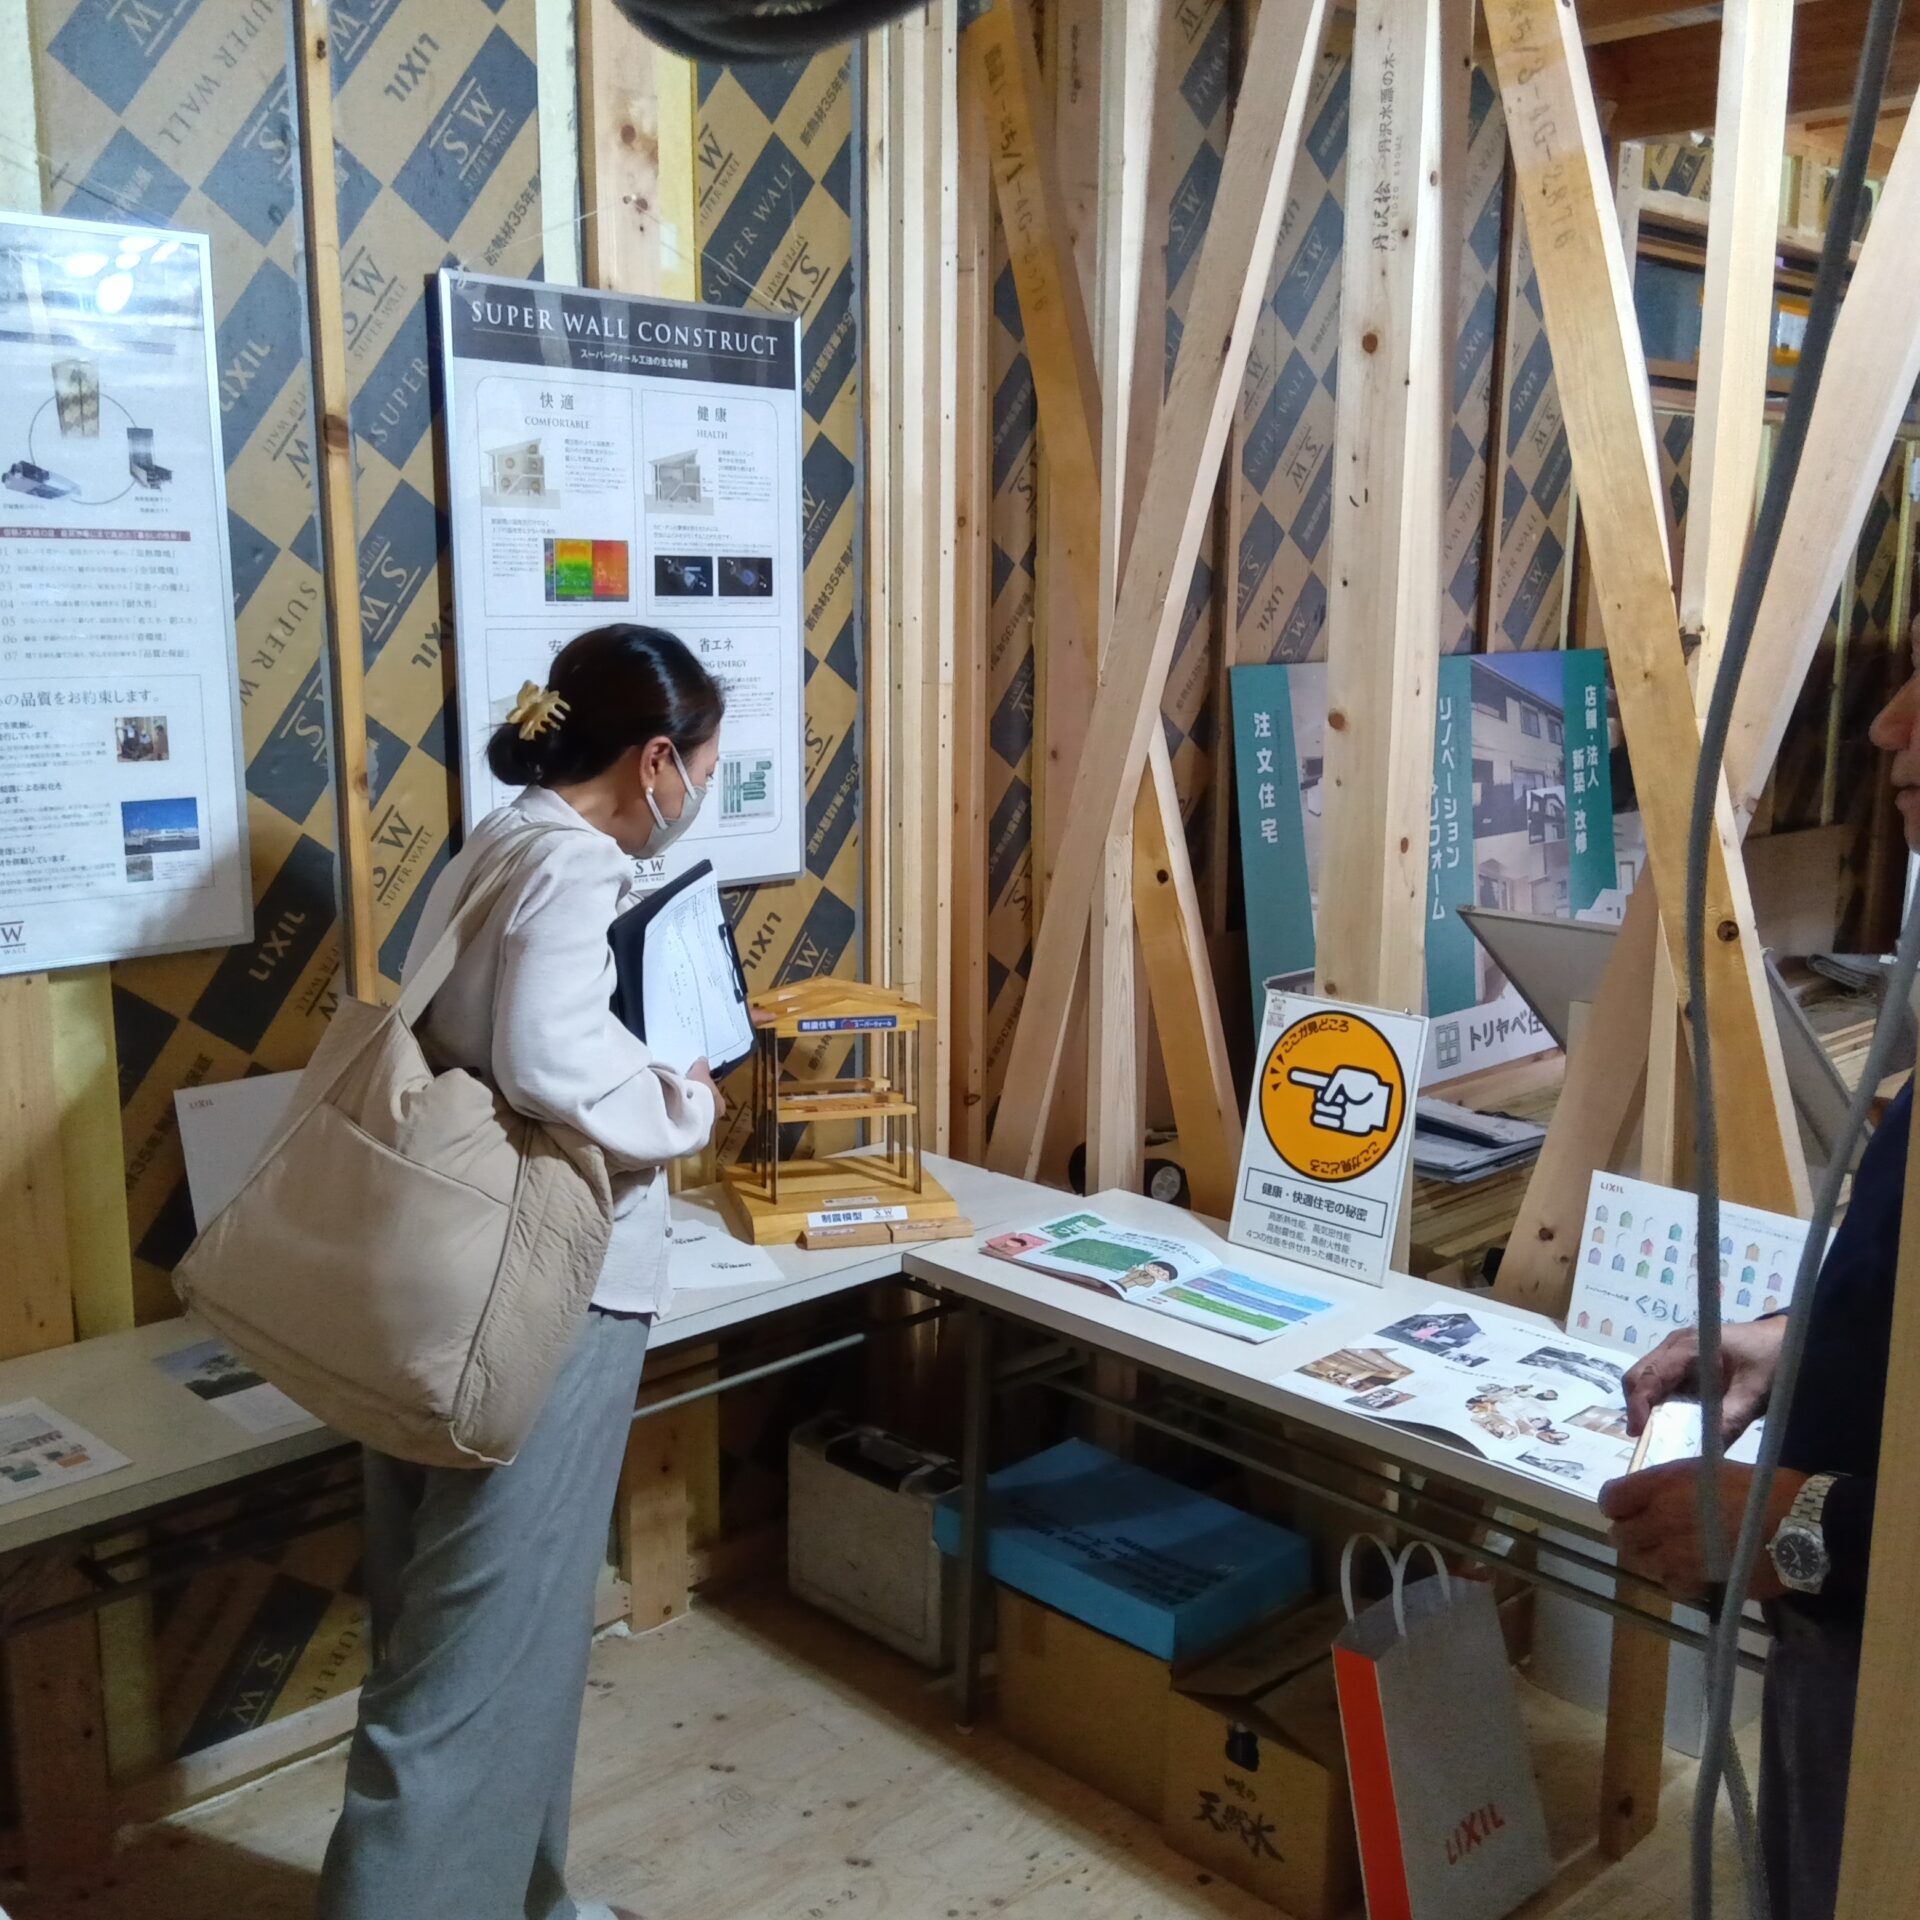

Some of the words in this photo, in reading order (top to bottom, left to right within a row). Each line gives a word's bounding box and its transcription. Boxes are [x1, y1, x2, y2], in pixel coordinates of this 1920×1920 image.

[383, 32, 441, 102] LIXIL
[708, 226, 759, 303] SUPER
[752, 161, 796, 223] WALL
[471, 299, 554, 332] SUPER
[563, 311, 629, 340] WALL
[637, 320, 779, 356] CONSTRUCT
[369, 356, 430, 444] SUPER
[539, 391, 575, 411] 快適
[696, 405, 728, 423] 健康
[524, 415, 592, 430] COMFORTABLE
[696, 428, 728, 440] HEALTH
[250, 580, 319, 670] SUPER
[1256, 585, 1285, 632] LIXIL
[698, 637, 735, 653] 省エネ
[1584, 684, 1599, 790] 店舗・法人
[1252, 710, 1279, 845] 注文住宅
[1438, 695, 1460, 870] リノベーション
[1571, 747, 1588, 855] 新築・改修
[248, 911, 306, 984] LIXIL
[742, 911, 782, 970] LIXIL
[1280, 1016, 1351, 1054] ここが見どころ
[1469, 1008, 1543, 1052] トリヤベ住
[1308, 1140, 1381, 1176] ここが見どころ
[1261, 1181, 1369, 1223] 健康・快適住宅の秘密
[1599, 1181, 1625, 1195] LIXIL
[821, 1211, 863, 1224] 制震模型
[1265, 1222, 1351, 1256] 高耐震性能、高耐火性能
[1267, 1210, 1352, 1244] 高断熱性能、高気密性能
[1245, 1229, 1369, 1273] 4つの性能を併せ持った構造材です。
[1634, 1294, 1699, 1324] くらし
[1193, 1789, 1286, 1863] 天然水
[1446, 1803, 1507, 1866] LIXIL
